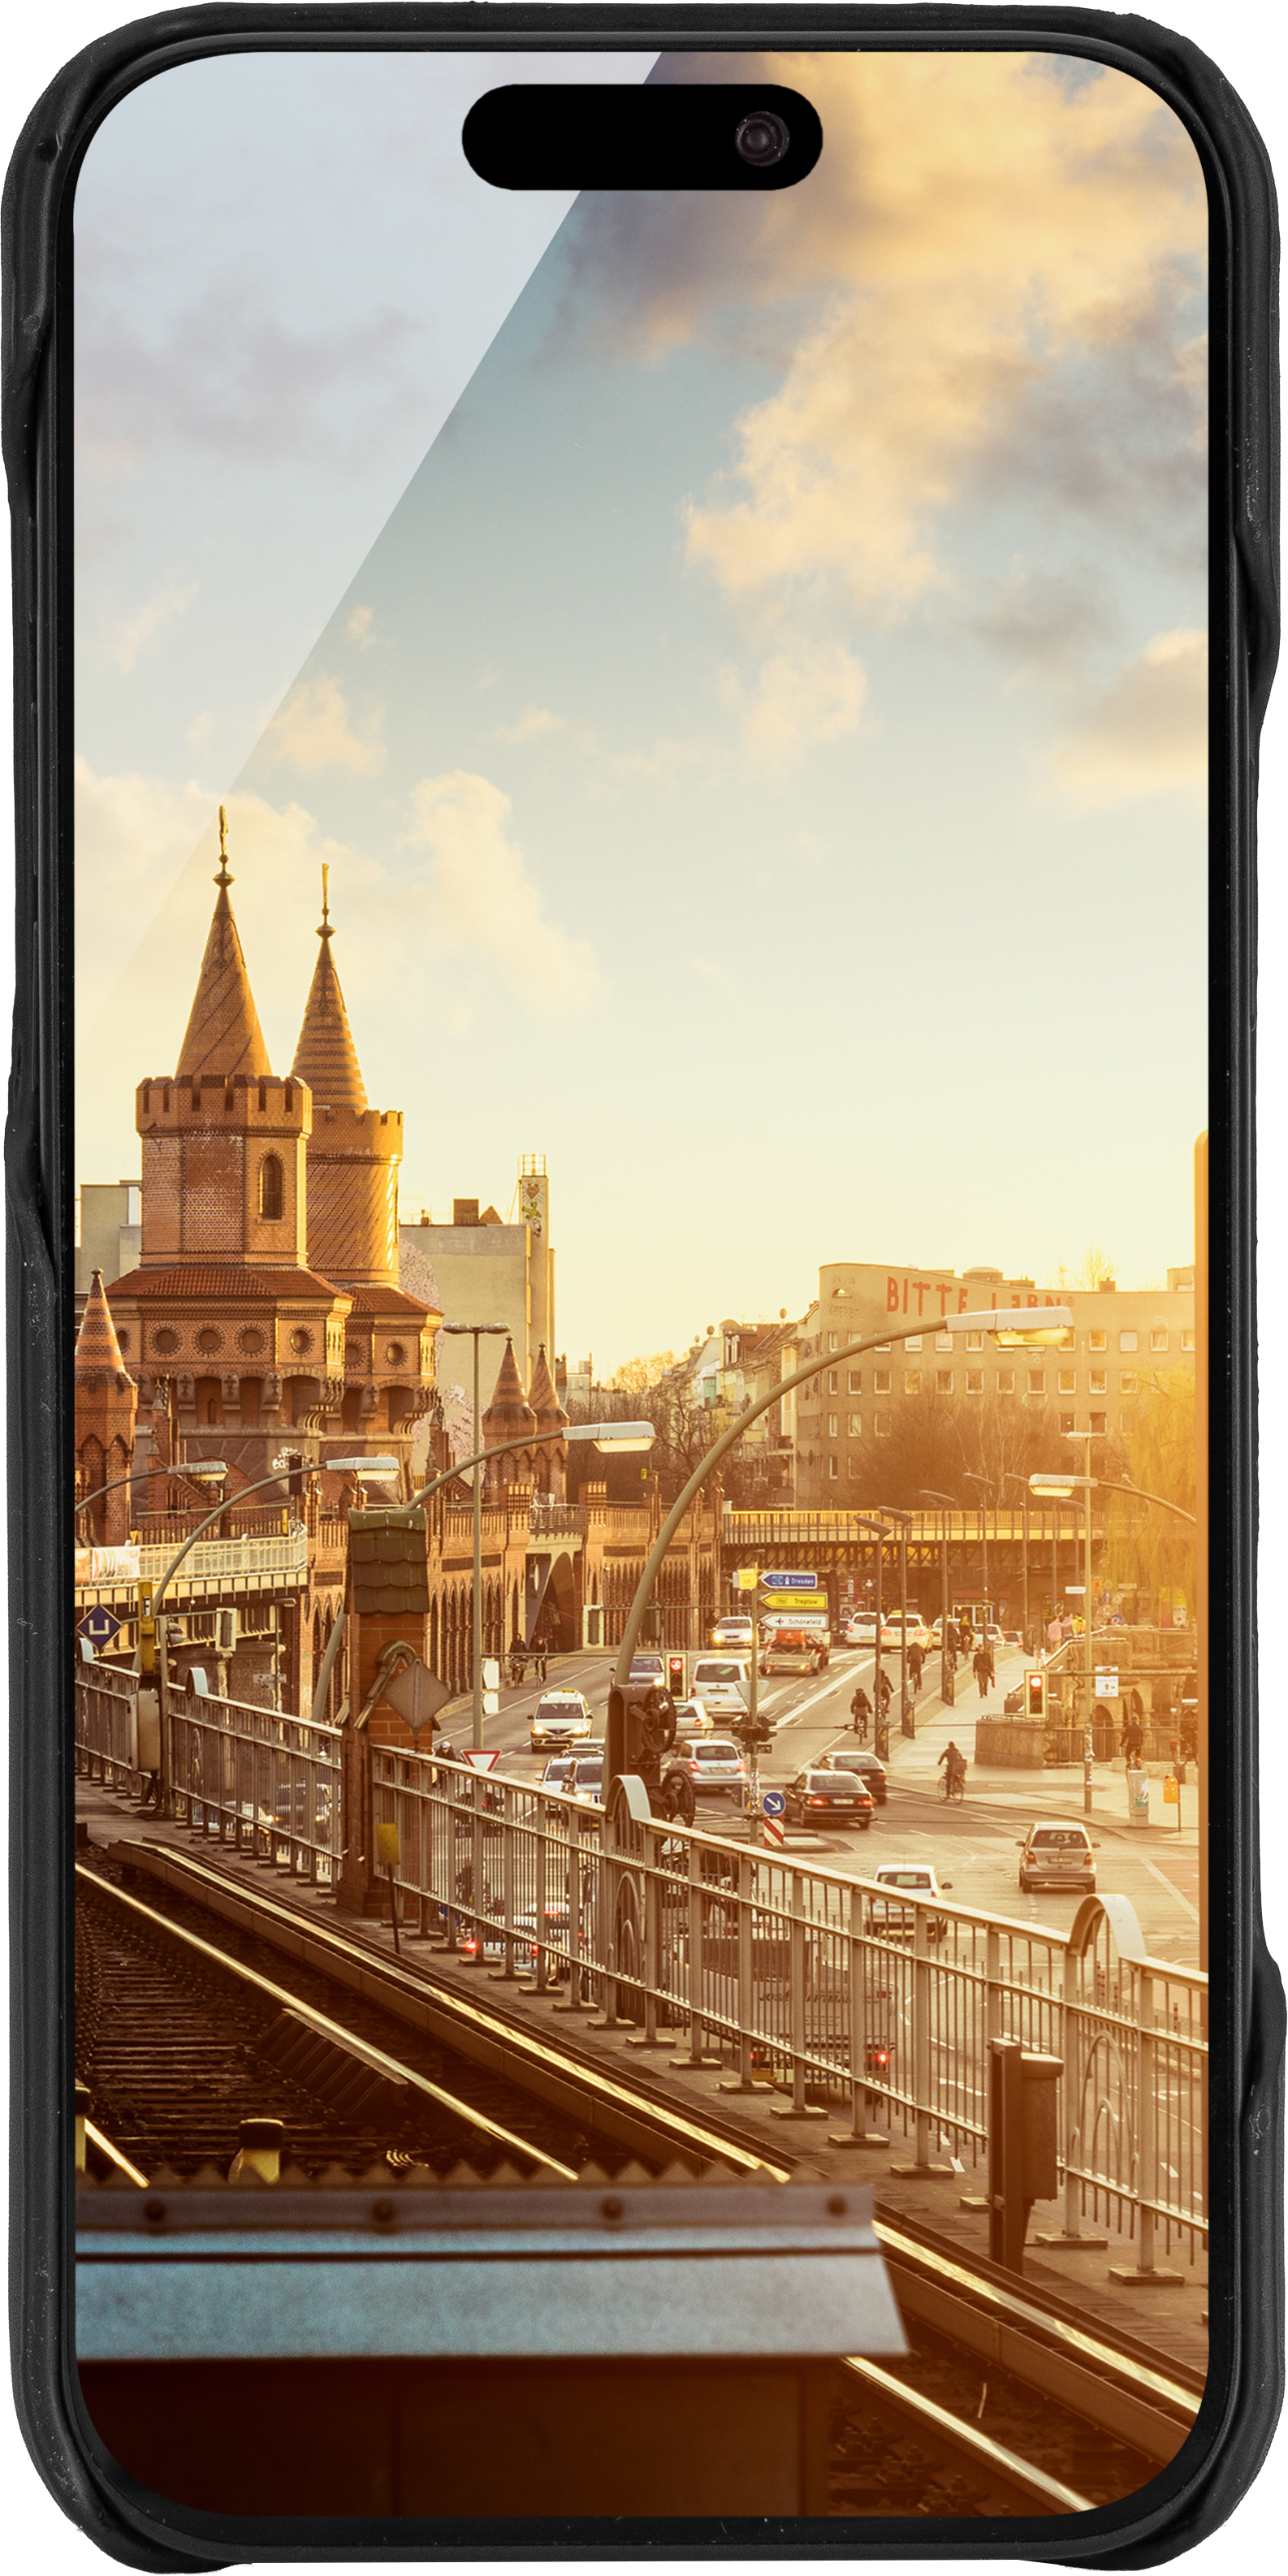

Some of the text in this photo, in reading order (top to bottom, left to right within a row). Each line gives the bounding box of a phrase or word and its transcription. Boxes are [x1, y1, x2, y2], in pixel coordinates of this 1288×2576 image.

[887, 1276, 968, 1316] BITTE
[143, 1597, 151, 1616] F
[89, 1619, 109, 1635] U
